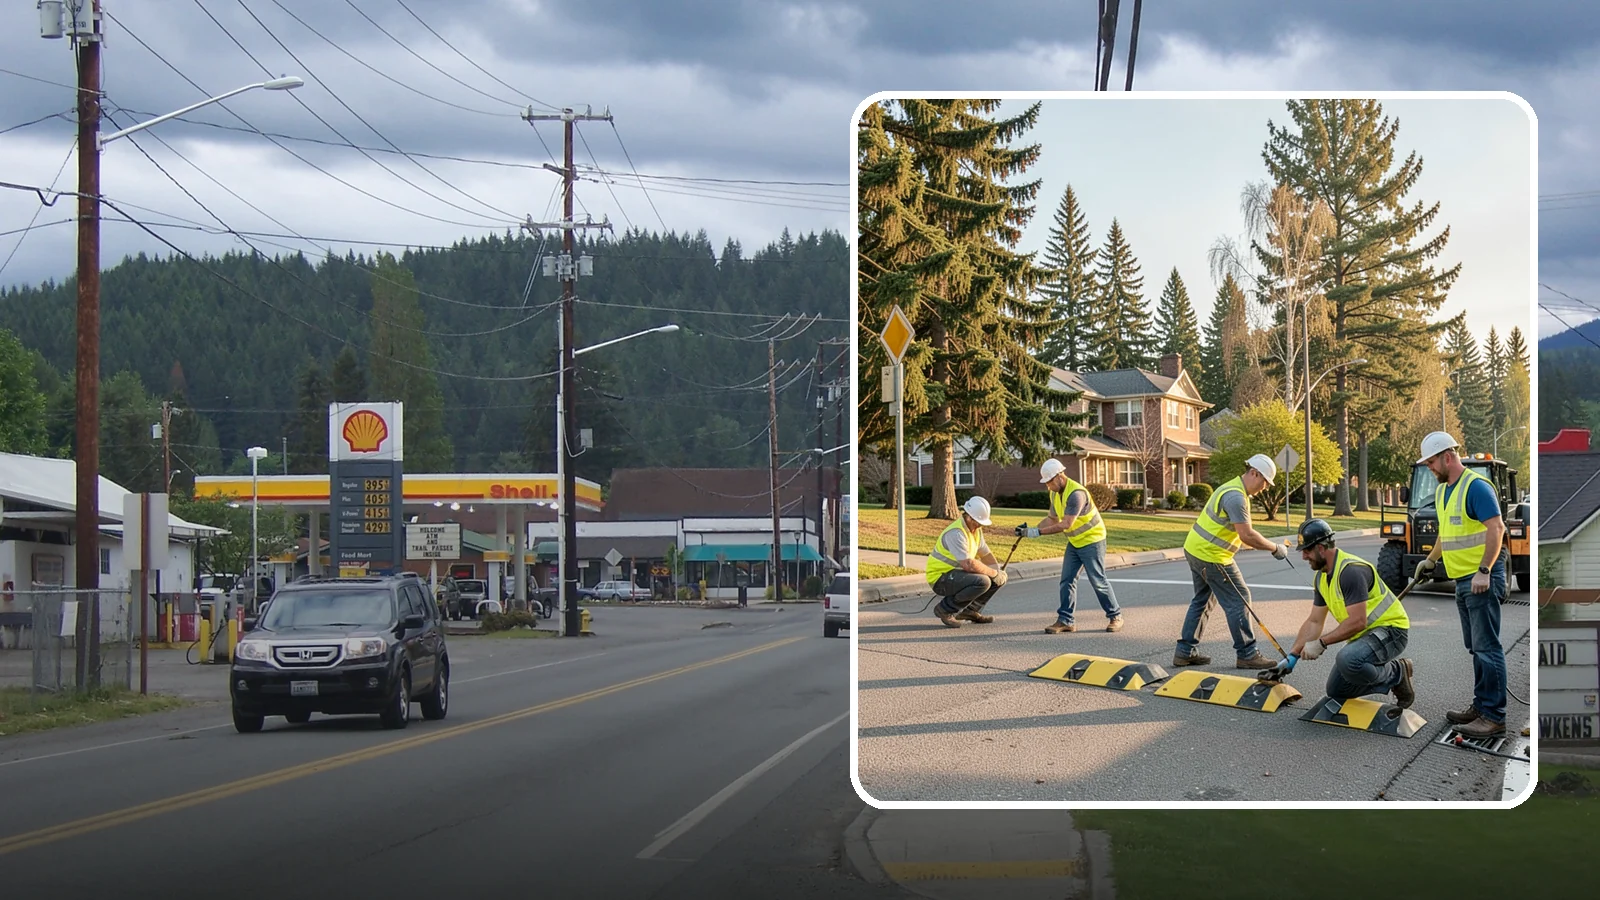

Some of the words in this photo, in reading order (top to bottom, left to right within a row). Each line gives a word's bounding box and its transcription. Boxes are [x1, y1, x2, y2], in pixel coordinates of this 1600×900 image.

[366, 480, 383, 490] 395
[490, 484, 547, 499] Shell
[366, 494, 383, 504] 405
[366, 508, 383, 518] 415
[366, 522, 383, 532] 429
